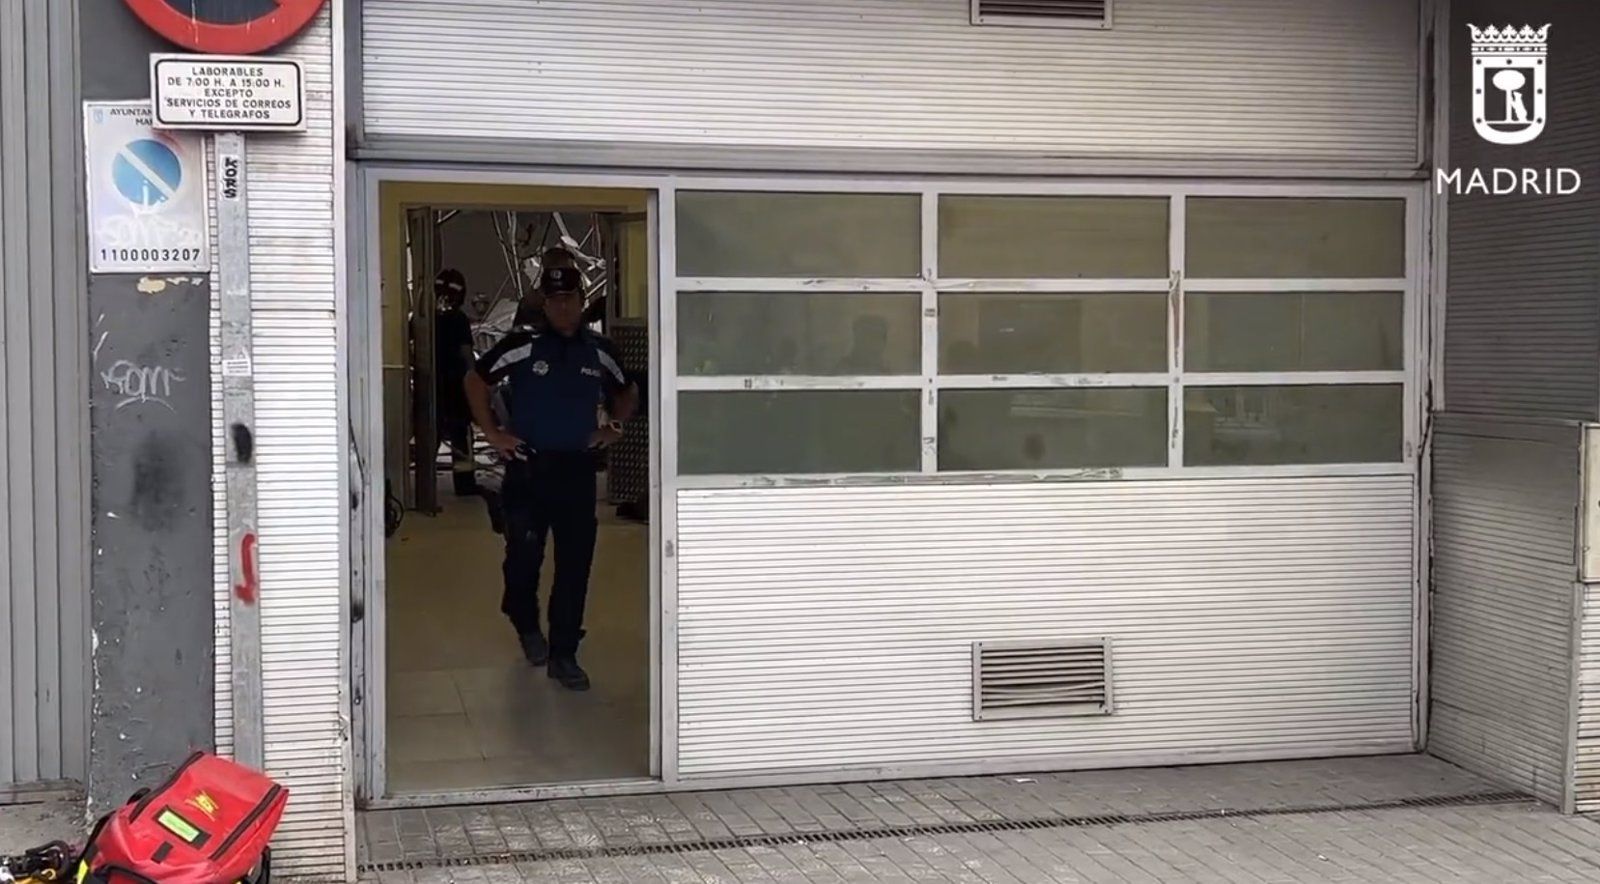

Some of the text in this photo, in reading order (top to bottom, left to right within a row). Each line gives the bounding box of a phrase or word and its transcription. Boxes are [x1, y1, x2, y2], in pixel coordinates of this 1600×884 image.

[192, 67, 263, 77] LABORABLES
[167, 77, 182, 86] DE
[214, 78, 225, 87] H.
[229, 78, 237, 86] A
[274, 80, 285, 88] H.
[204, 89, 253, 98] EXCEPTO
[166, 98, 292, 109] SERVICIOS DE CORREOS
[189, 109, 270, 119] Y TELEGRAFOS
[224, 157, 238, 199] KORS
[101, 249, 200, 261] 1100003207
